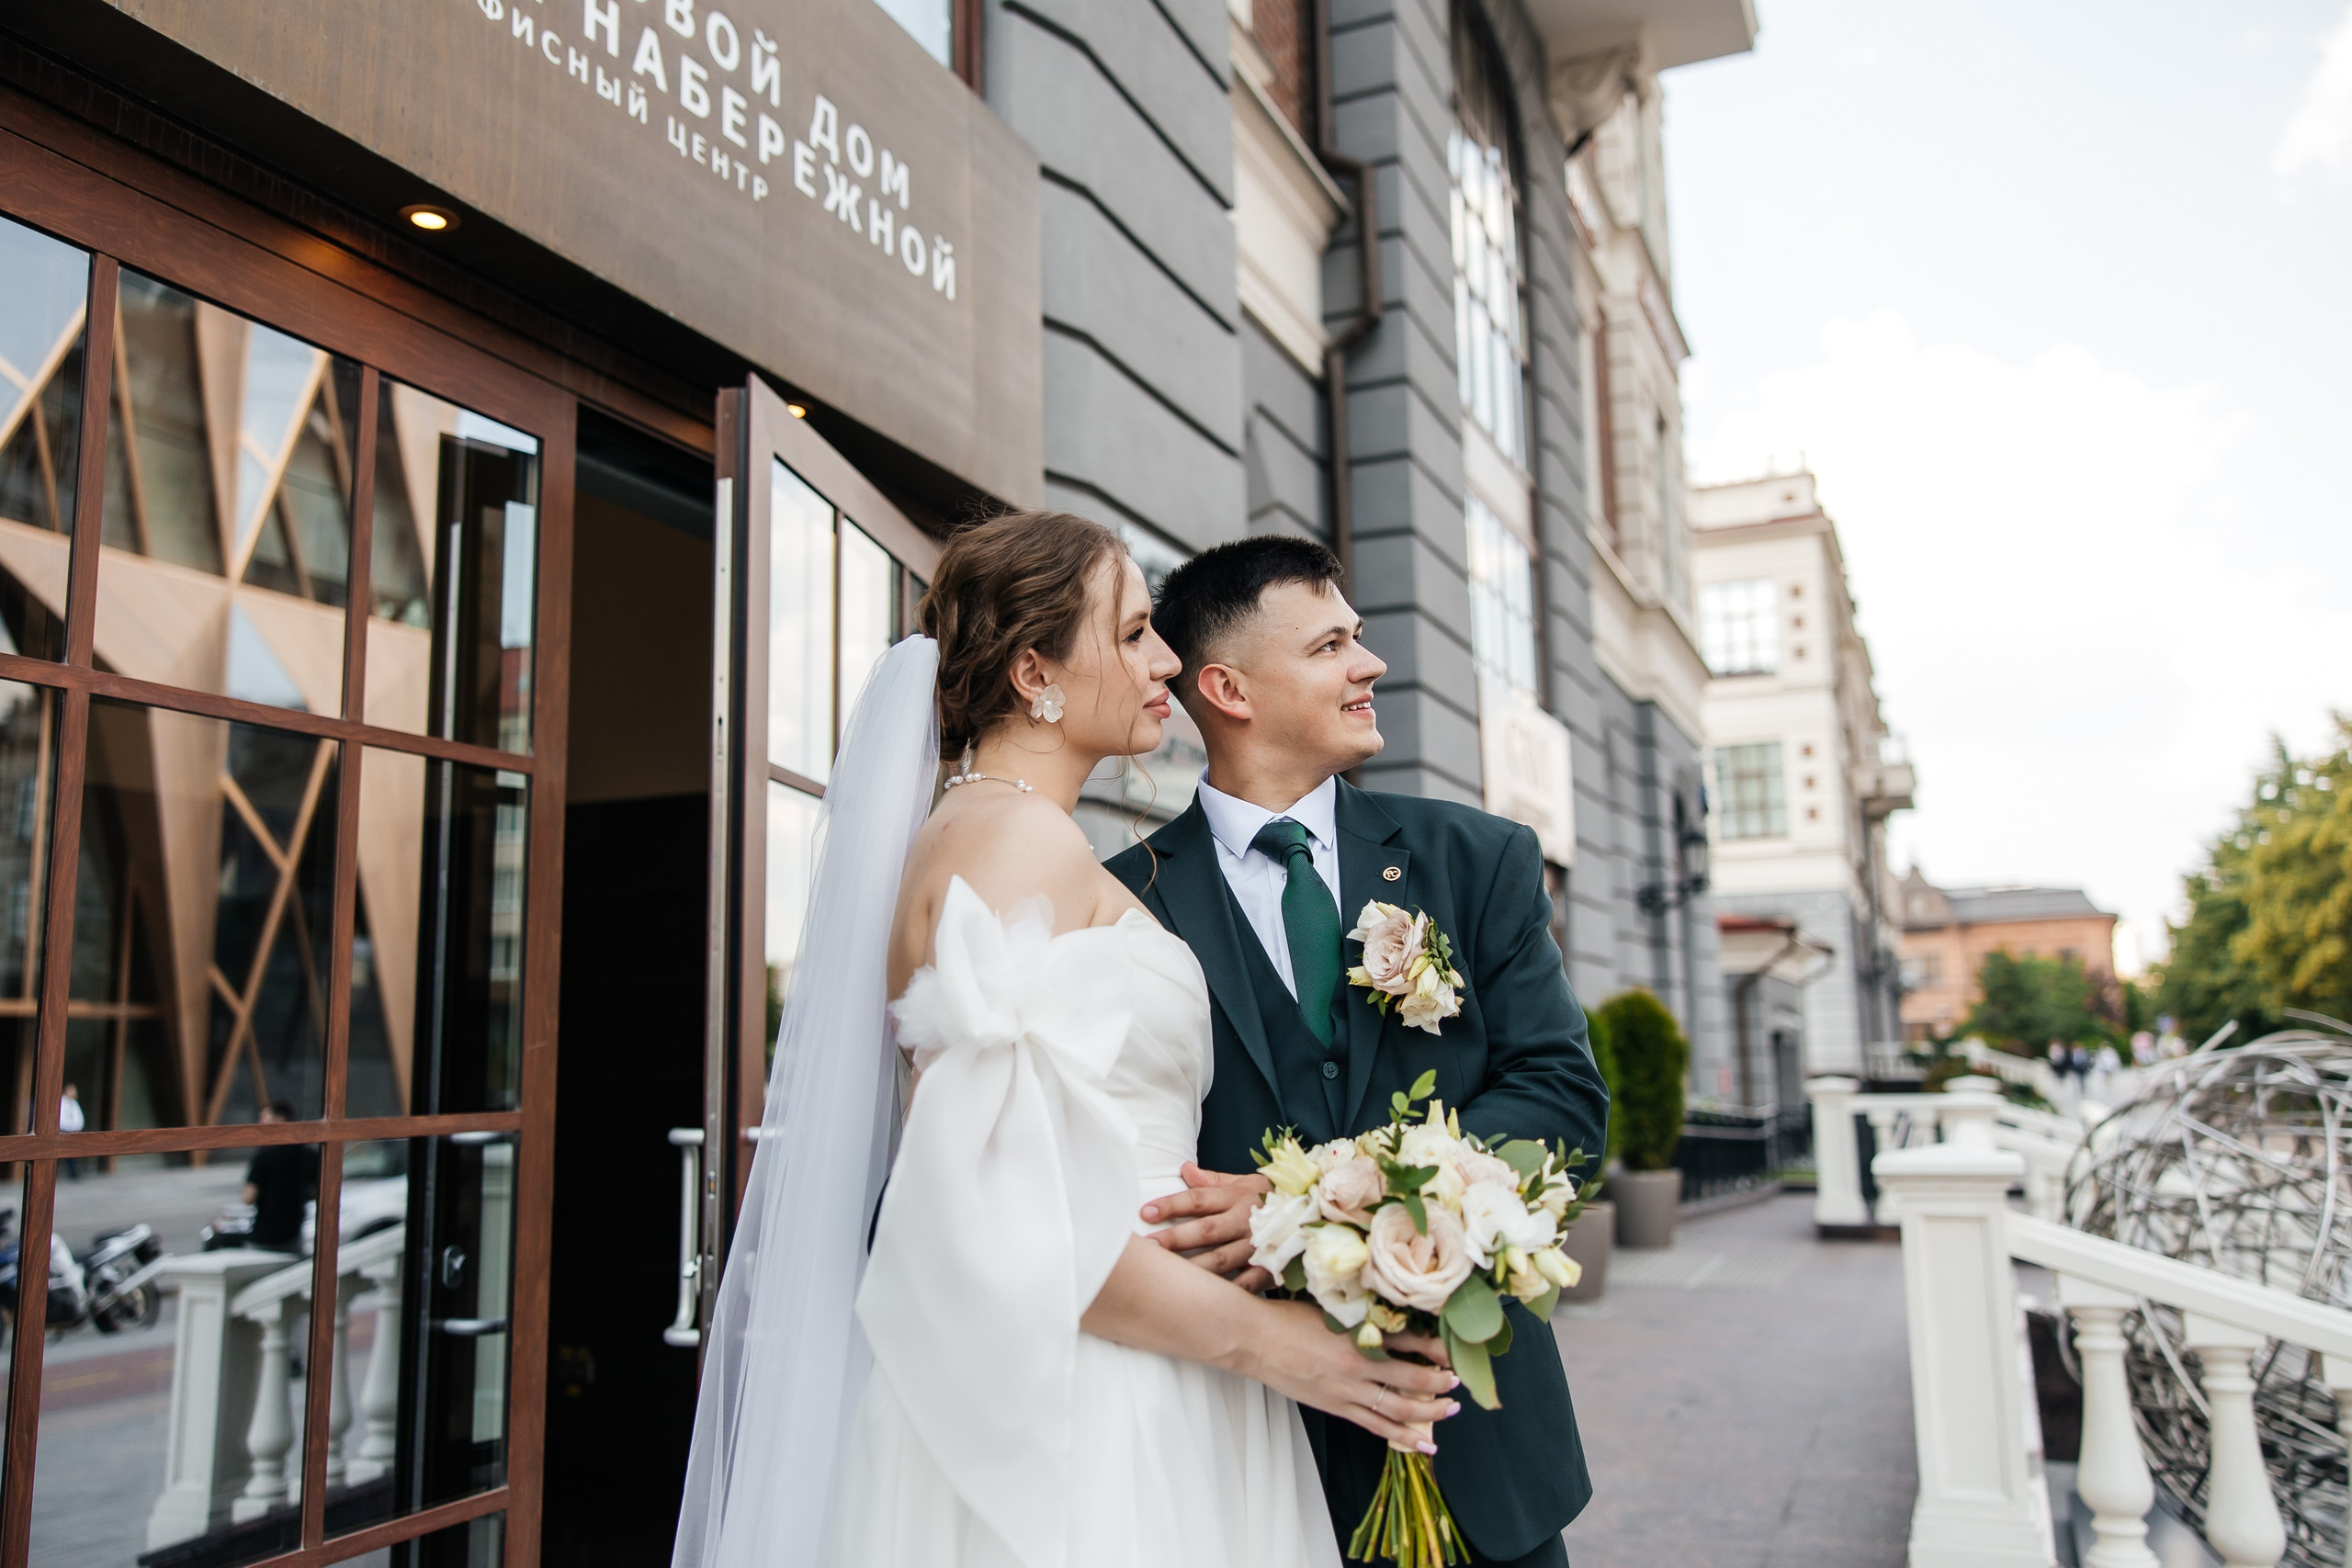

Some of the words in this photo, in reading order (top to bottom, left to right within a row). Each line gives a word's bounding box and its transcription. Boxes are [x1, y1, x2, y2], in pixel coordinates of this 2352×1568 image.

[583, 0, 956, 300] НАБЕРЕЖНОЙ
[636, 0, 780, 107] ВОЙ
[808, 95, 910, 209] ДОМ
[667, 116, 768, 201] ЦЕНТР
